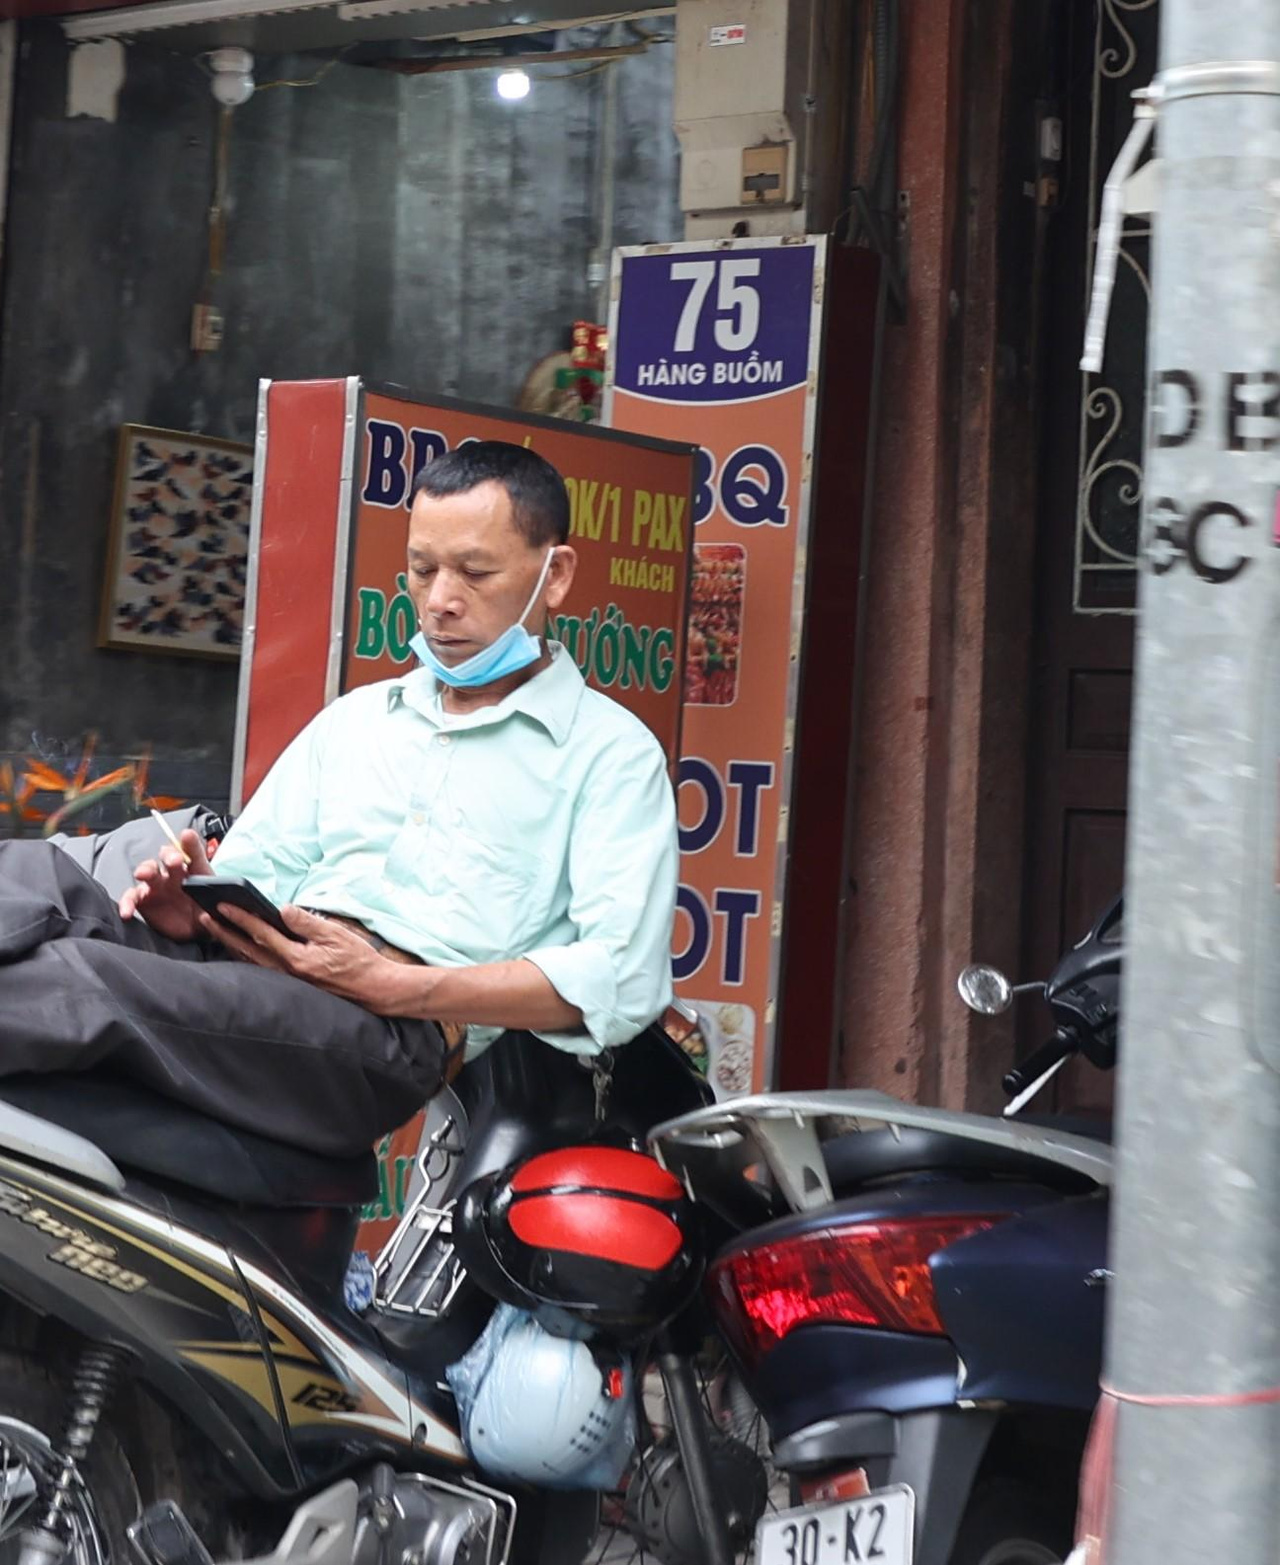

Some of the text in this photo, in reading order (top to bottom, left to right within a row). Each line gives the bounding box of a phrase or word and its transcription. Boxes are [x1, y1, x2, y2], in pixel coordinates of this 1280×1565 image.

[670, 258, 761, 352] 75
[637, 350, 784, 386] HÀNG BUỒM
[631, 489, 687, 553] PAX
[609, 556, 676, 592] KHÁCH
[354, 571, 418, 665] BÒ
[781, 1504, 886, 1565] 30-K2
